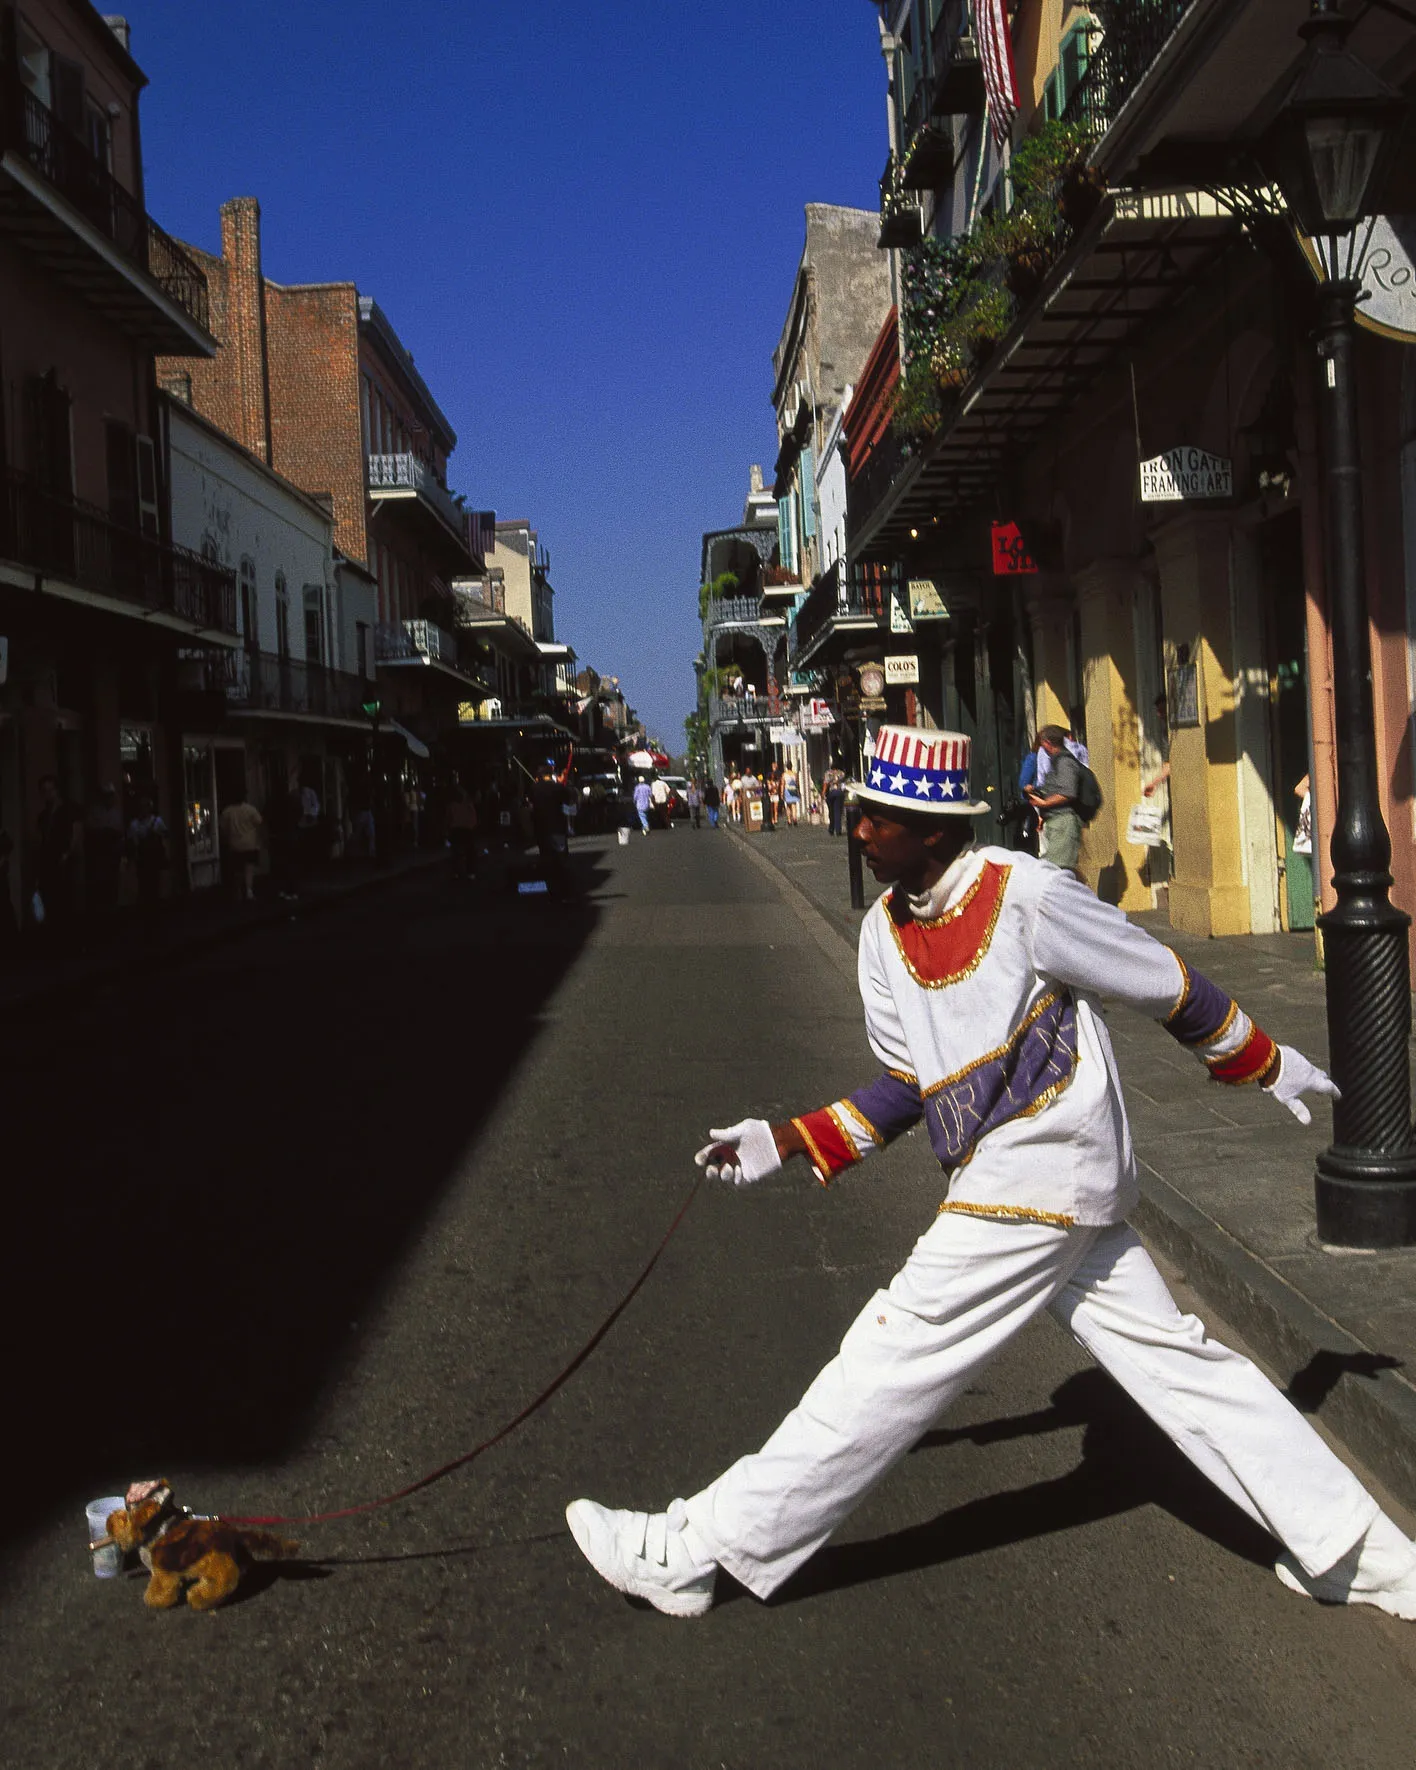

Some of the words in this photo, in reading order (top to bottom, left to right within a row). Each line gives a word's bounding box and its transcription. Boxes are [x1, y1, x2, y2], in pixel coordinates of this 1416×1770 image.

[1361, 248, 1416, 298] Ro
[1143, 449, 1183, 473] IRON
[1188, 447, 1231, 471] GATE
[1143, 472, 1199, 493] FRAMING
[1207, 472, 1230, 492] ART
